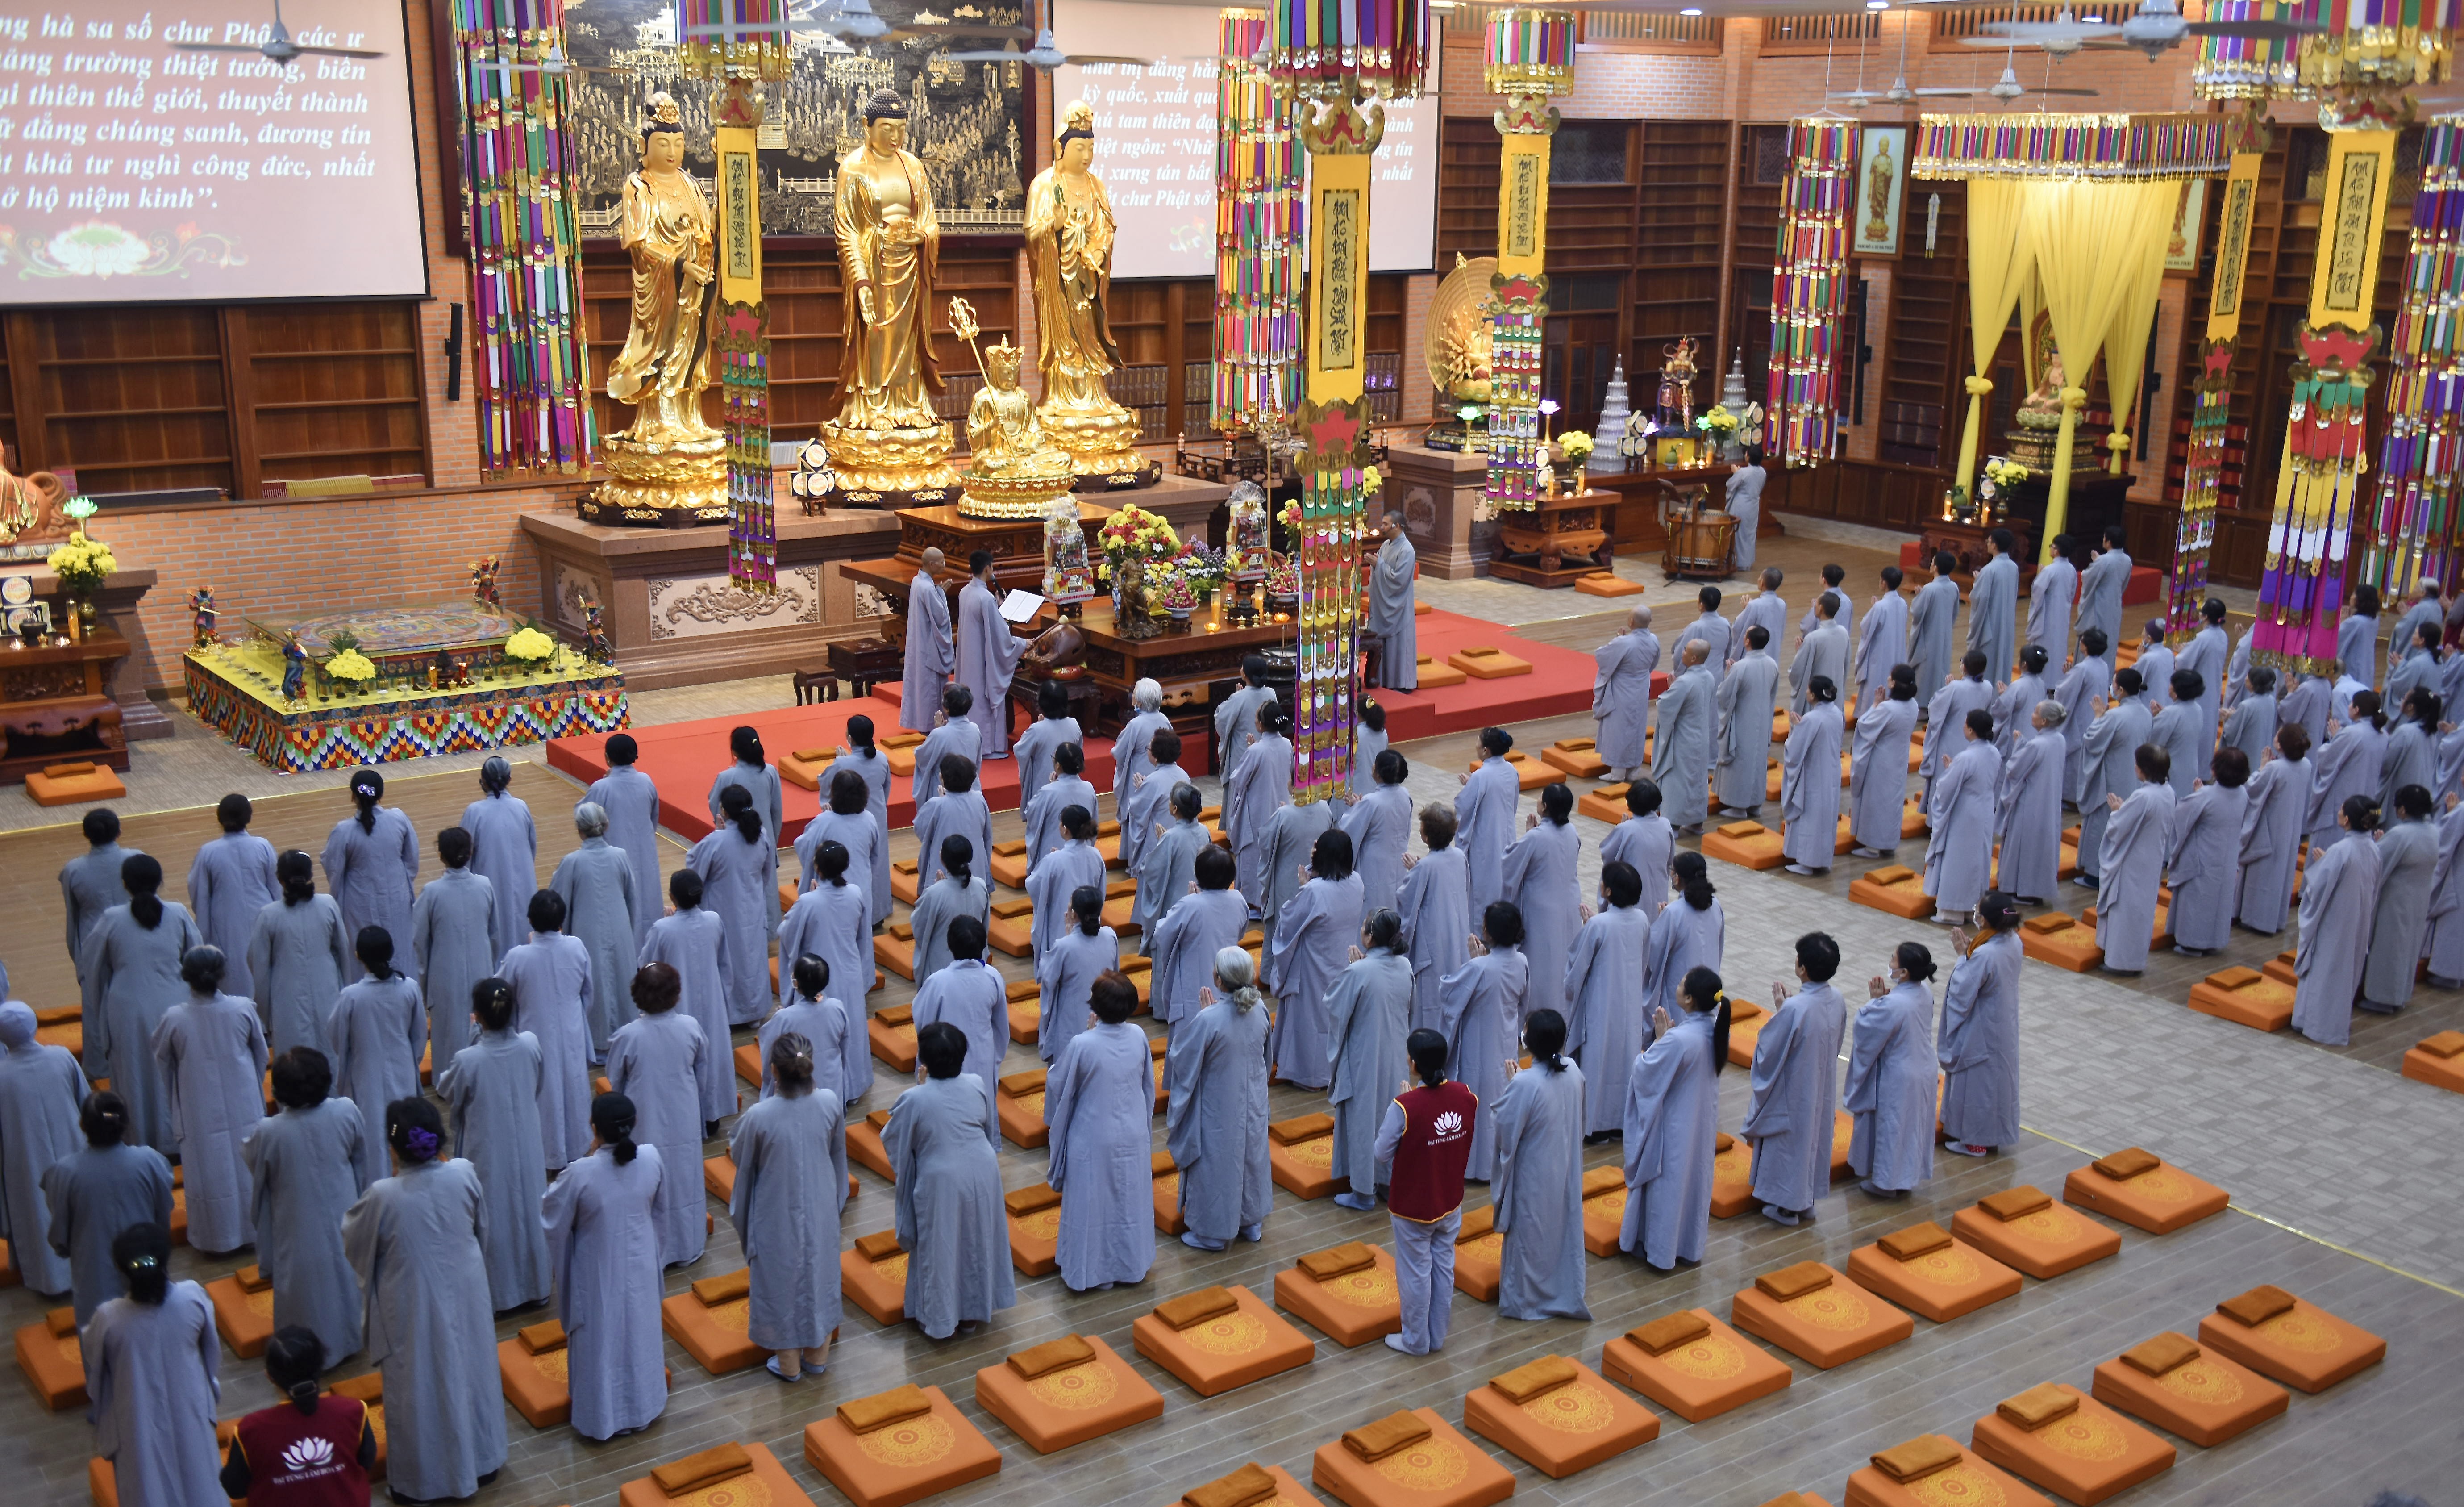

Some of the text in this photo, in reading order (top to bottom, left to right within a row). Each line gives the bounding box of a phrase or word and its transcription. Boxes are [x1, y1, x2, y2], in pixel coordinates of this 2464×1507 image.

[41, 12, 74, 38] hà
[87, 21, 113, 39] sa
[125, 11, 153, 40] số
[164, 19, 213, 42] chư
[223, 22, 276, 48] Phậ
[297, 25, 337, 46] các
[64, 50, 153, 80] trường
[163, 54, 218, 81] thiệt
[229, 56, 306, 83] tướng,
[1149, 55, 1186, 81] đẳng
[29, 82, 95, 106] thiên
[105, 80, 144, 108] thế
[153, 86, 208, 113] giới,
[219, 85, 293, 116] thuyết
[301, 91, 368, 113] thành
[1082, 84, 1100, 105] kỳ
[1107, 81, 1148, 106] quốc,
[1153, 82, 1189, 104] xuất
[96, 118, 175, 146] chúng
[183, 121, 249, 146] sanh,
[258, 122, 334, 149] đương
[341, 124, 371, 144] tín
[1118, 114, 1147, 129] tam
[1153, 113, 1190, 129] thiên
[1122, 138, 1166, 159] ngôn:
[1395, 141, 1413, 156] tín
[24, 150, 73, 174] khả
[85, 154, 113, 174] tư
[125, 153, 180, 180] nghì
[192, 154, 250, 180] công
[261, 155, 311, 179] đức,
[323, 150, 375, 176] nhất
[1109, 168, 1150, 184] xưng
[1157, 164, 1180, 180] tán
[1187, 159, 1211, 181] bất
[1382, 161, 1414, 180] nhất
[27, 185, 59, 213] hộ
[68, 186, 130, 213] niệm
[1121, 190, 1152, 207] chư
[1155, 190, 1190, 210] Phật
[1194, 189, 1211, 206] sở
